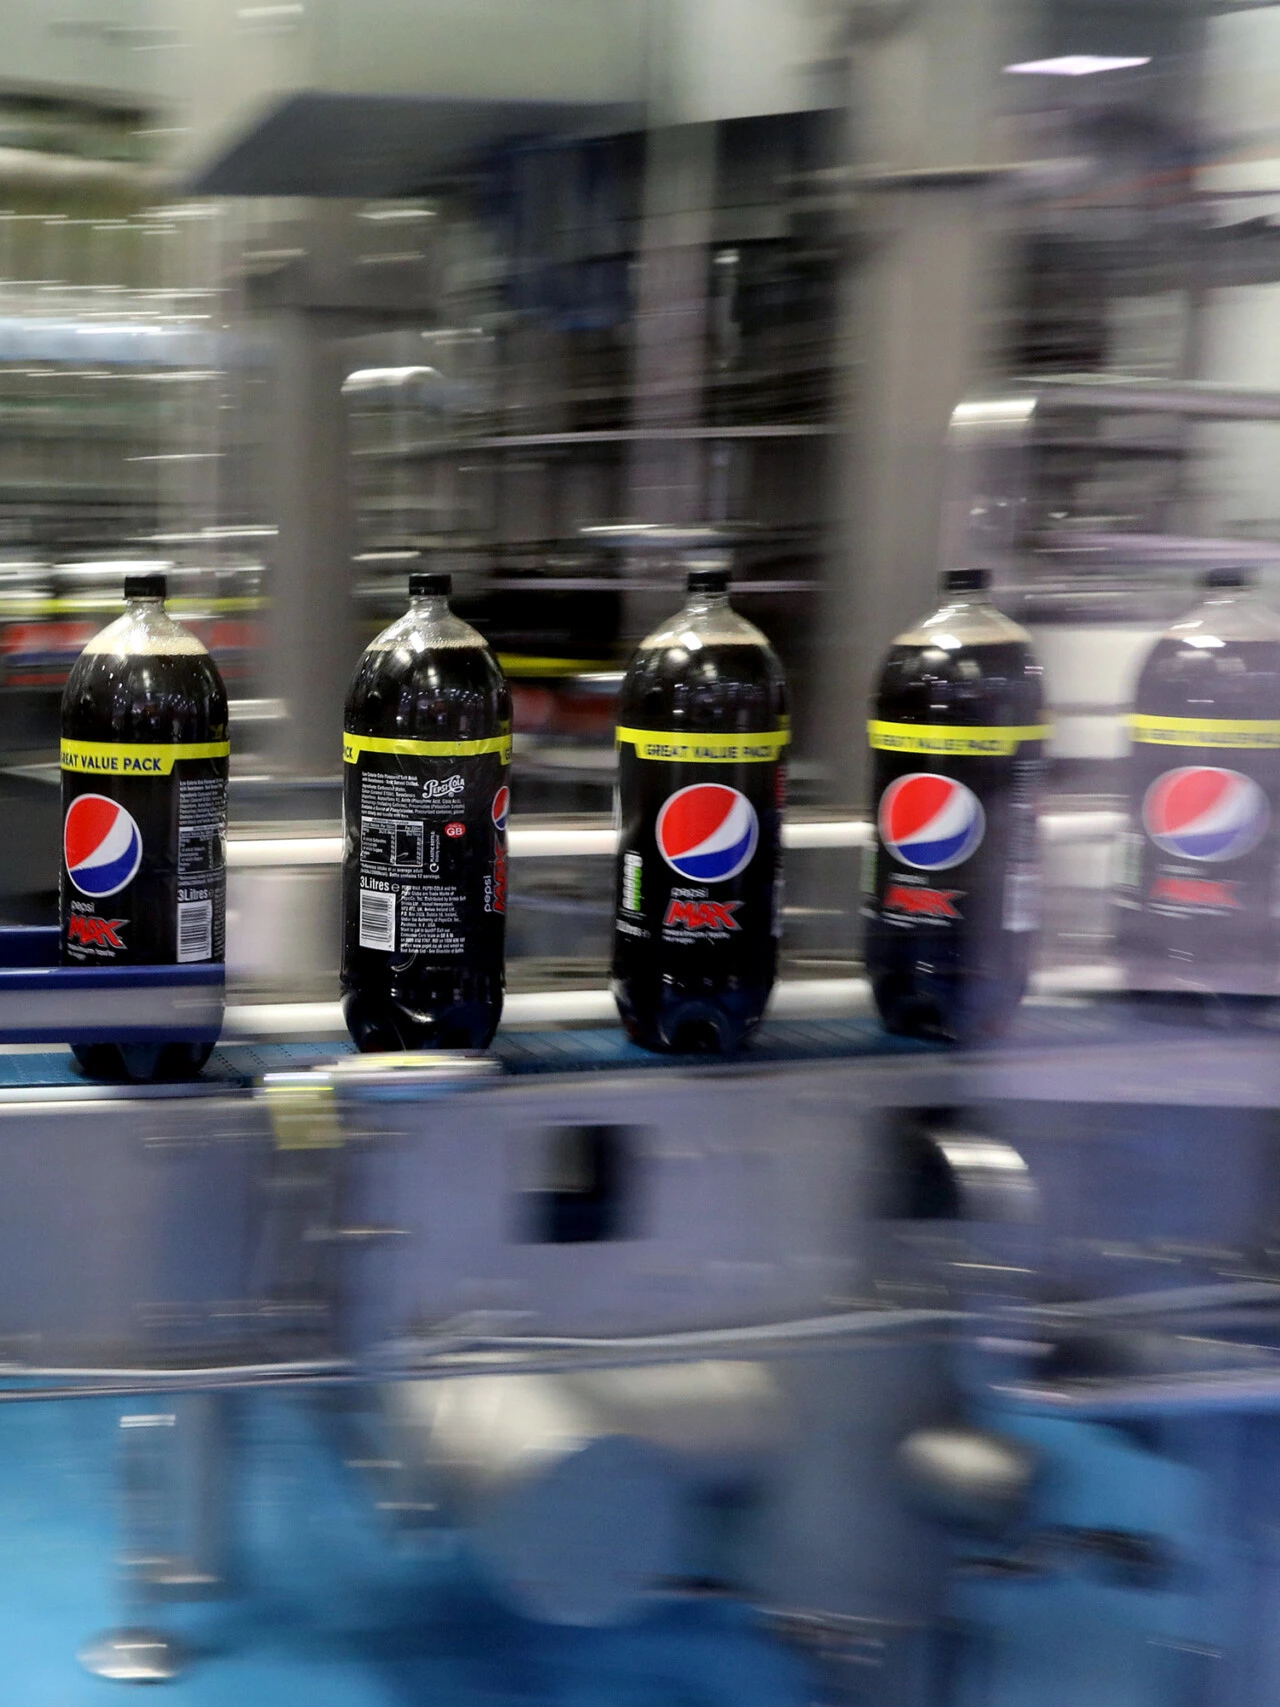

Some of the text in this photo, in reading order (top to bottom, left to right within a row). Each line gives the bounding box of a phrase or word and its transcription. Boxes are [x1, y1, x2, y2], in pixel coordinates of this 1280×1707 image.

[646, 744, 688, 758] GREAT
[81, 755, 118, 770] VALUE
[123, 758, 161, 771] PACK
[446, 827, 463, 836] GB
[359, 876, 390, 892] 3Litres
[177, 888, 208, 901] 3Litres
[483, 875, 493, 912] pepsi
[663, 899, 745, 931] MAX
[68, 912, 131, 950] MAX
